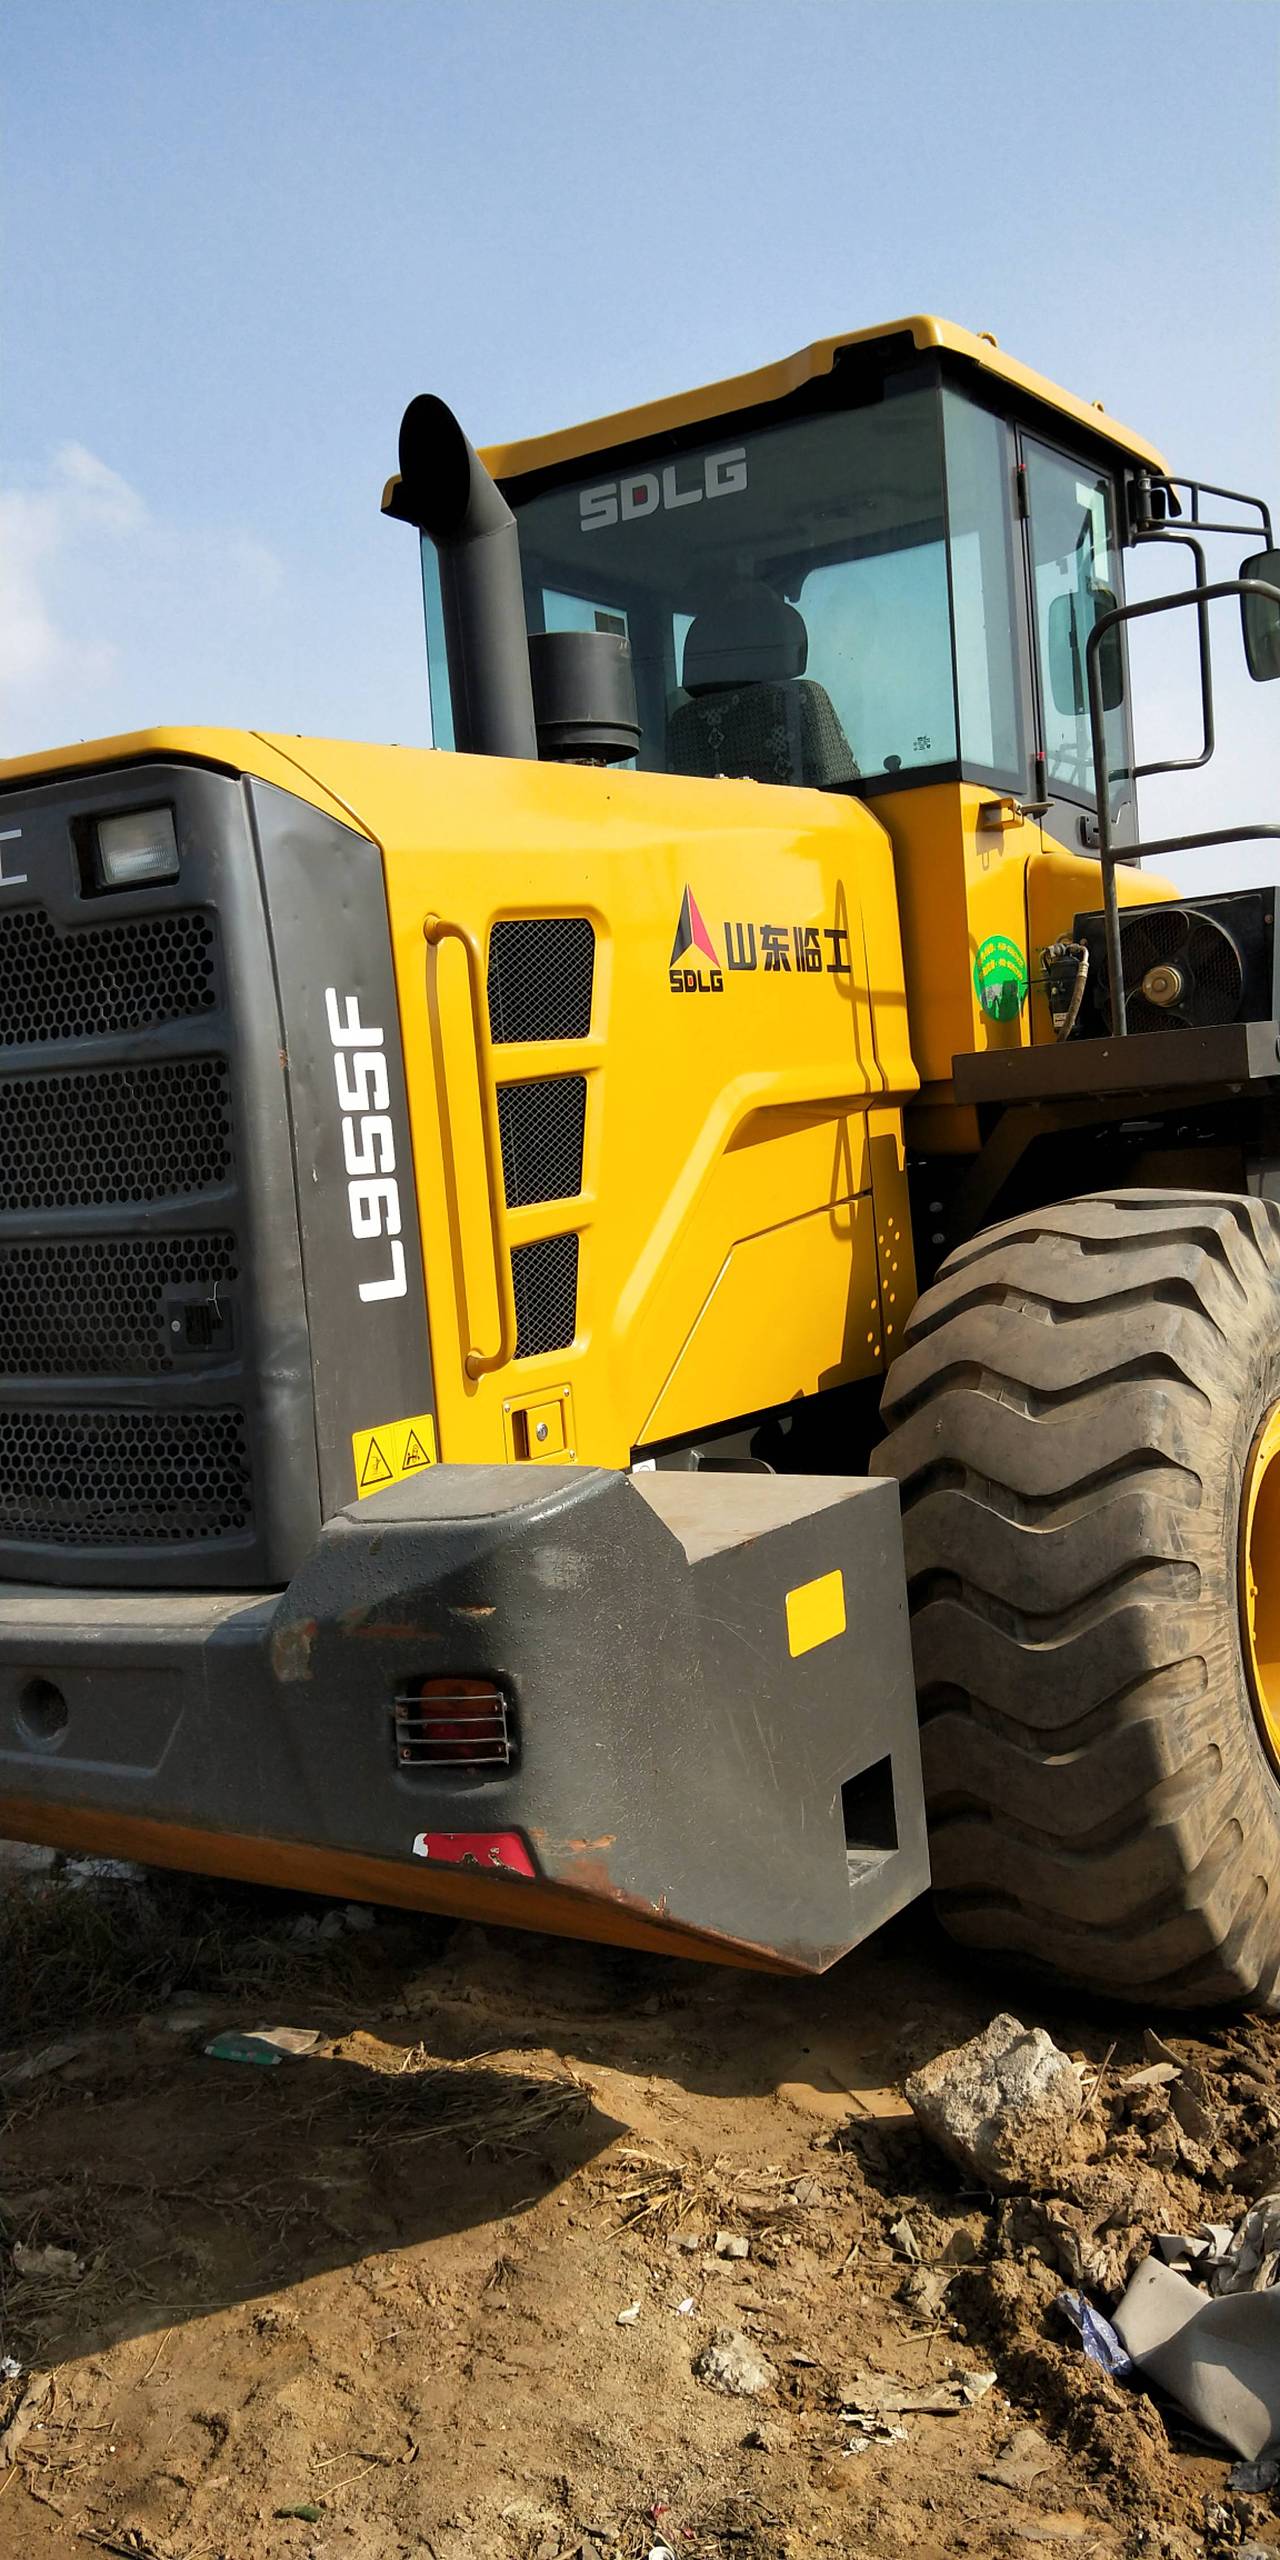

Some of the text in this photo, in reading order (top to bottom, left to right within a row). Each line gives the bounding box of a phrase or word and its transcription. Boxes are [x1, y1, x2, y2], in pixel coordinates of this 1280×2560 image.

[579, 447, 748, 532] SDLG
[669, 969, 724, 993] SDLG
[723, 921, 852, 974] 山东临工
[324, 986, 408, 1303] L955F
